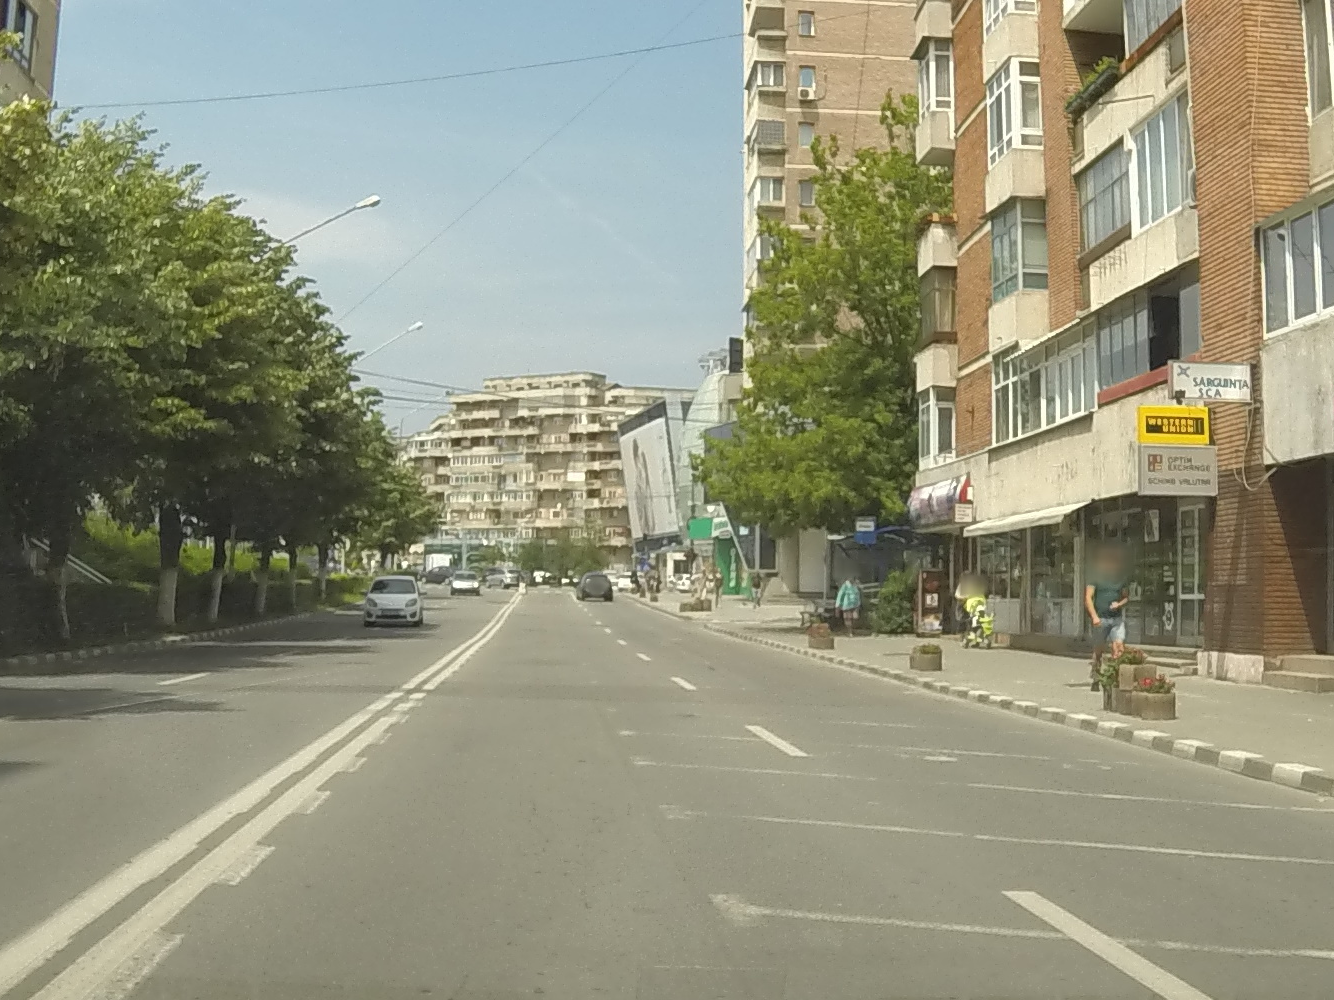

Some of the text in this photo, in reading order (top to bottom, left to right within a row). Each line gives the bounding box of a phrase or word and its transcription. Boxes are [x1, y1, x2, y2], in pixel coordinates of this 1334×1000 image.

[1198, 388, 1223, 399] SCA
[1147, 417, 1194, 426] WESTERN
[1162, 424, 1194, 433] UNION
